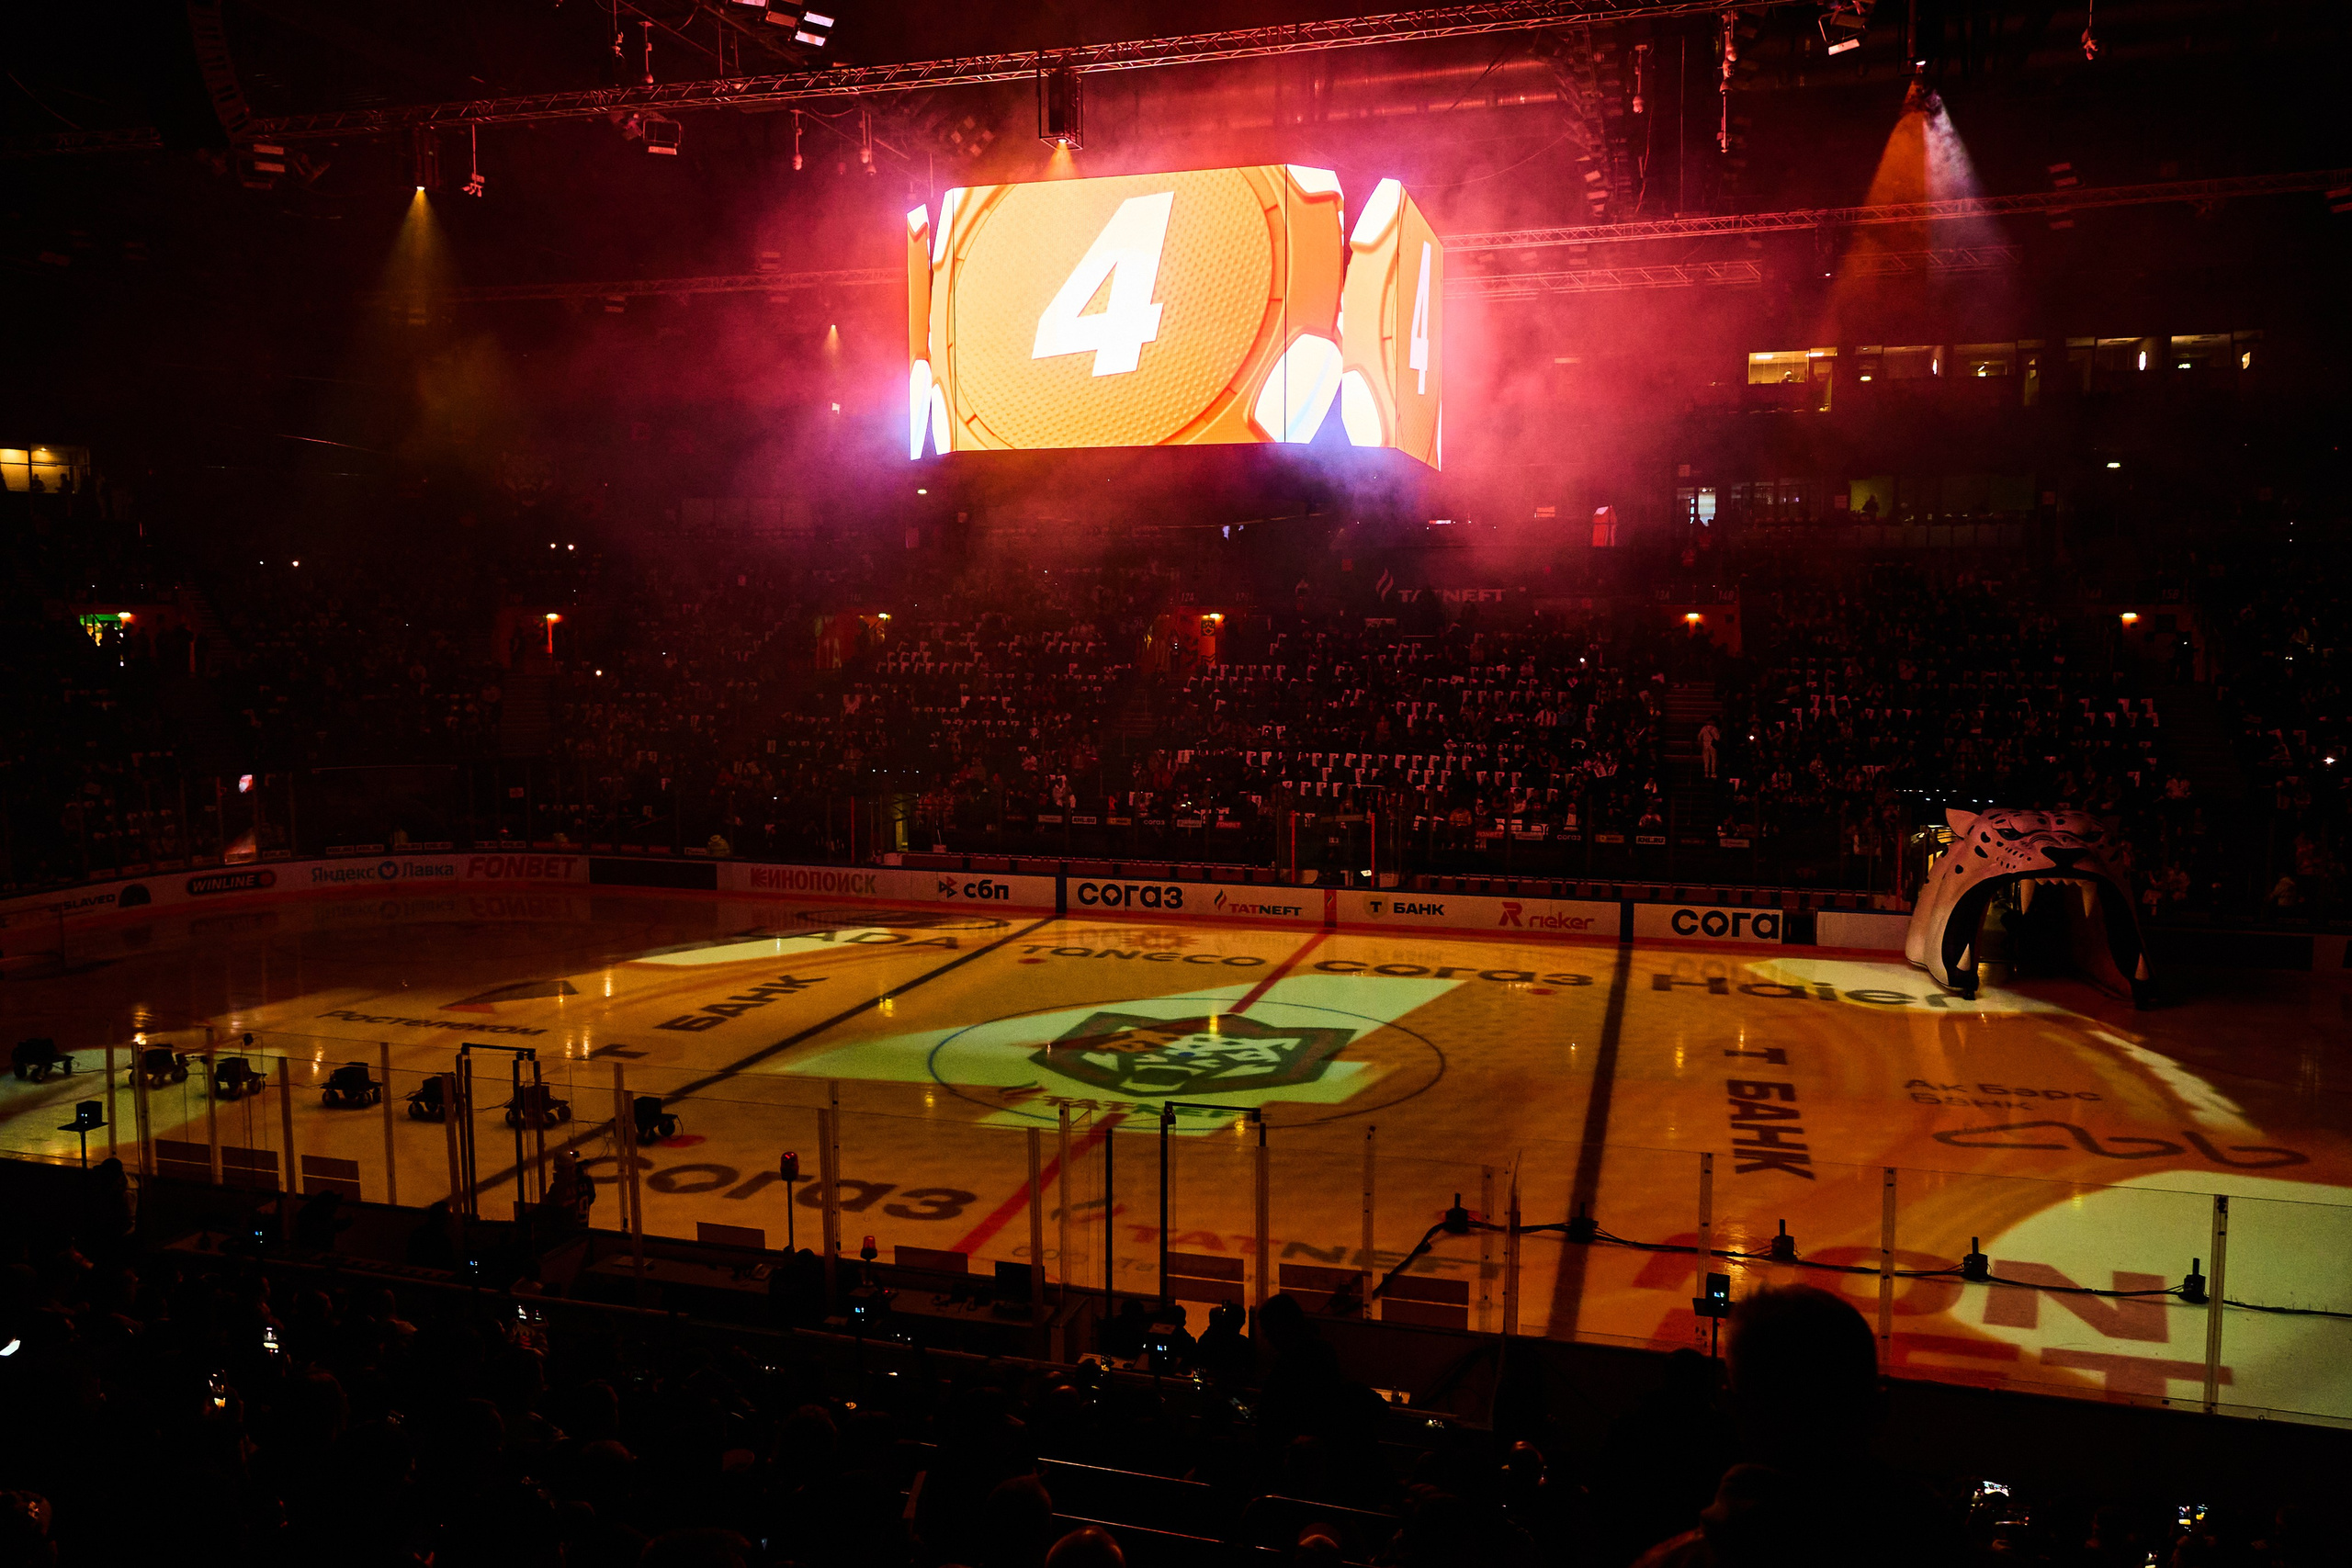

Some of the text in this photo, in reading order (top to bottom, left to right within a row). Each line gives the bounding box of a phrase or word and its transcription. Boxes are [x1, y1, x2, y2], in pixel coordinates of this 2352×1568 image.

[1032, 191, 1174, 377] 4
[1409, 241, 1430, 395] 4
[1397, 589, 1506, 603] TNEFT
[311, 861, 455, 883] Яндекс Лавка
[466, 855, 578, 879] FONBET
[191, 874, 256, 893] WINLINE
[751, 868, 877, 895] КИНОПОИСК
[964, 879, 1010, 900] сбп
[1078, 883, 1183, 908] согаз
[1228, 903, 1302, 917] TATNEFT
[1393, 902, 1445, 916] БАНК
[1529, 913, 1595, 931] rieker
[1314, 960, 1594, 987] согаз
[652, 975, 829, 1032] БАНК
[316, 1010, 549, 1036] Ростелеком
[1976, 1082, 2103, 1101] Барс
[1726, 1078, 1816, 1180] БАНК
